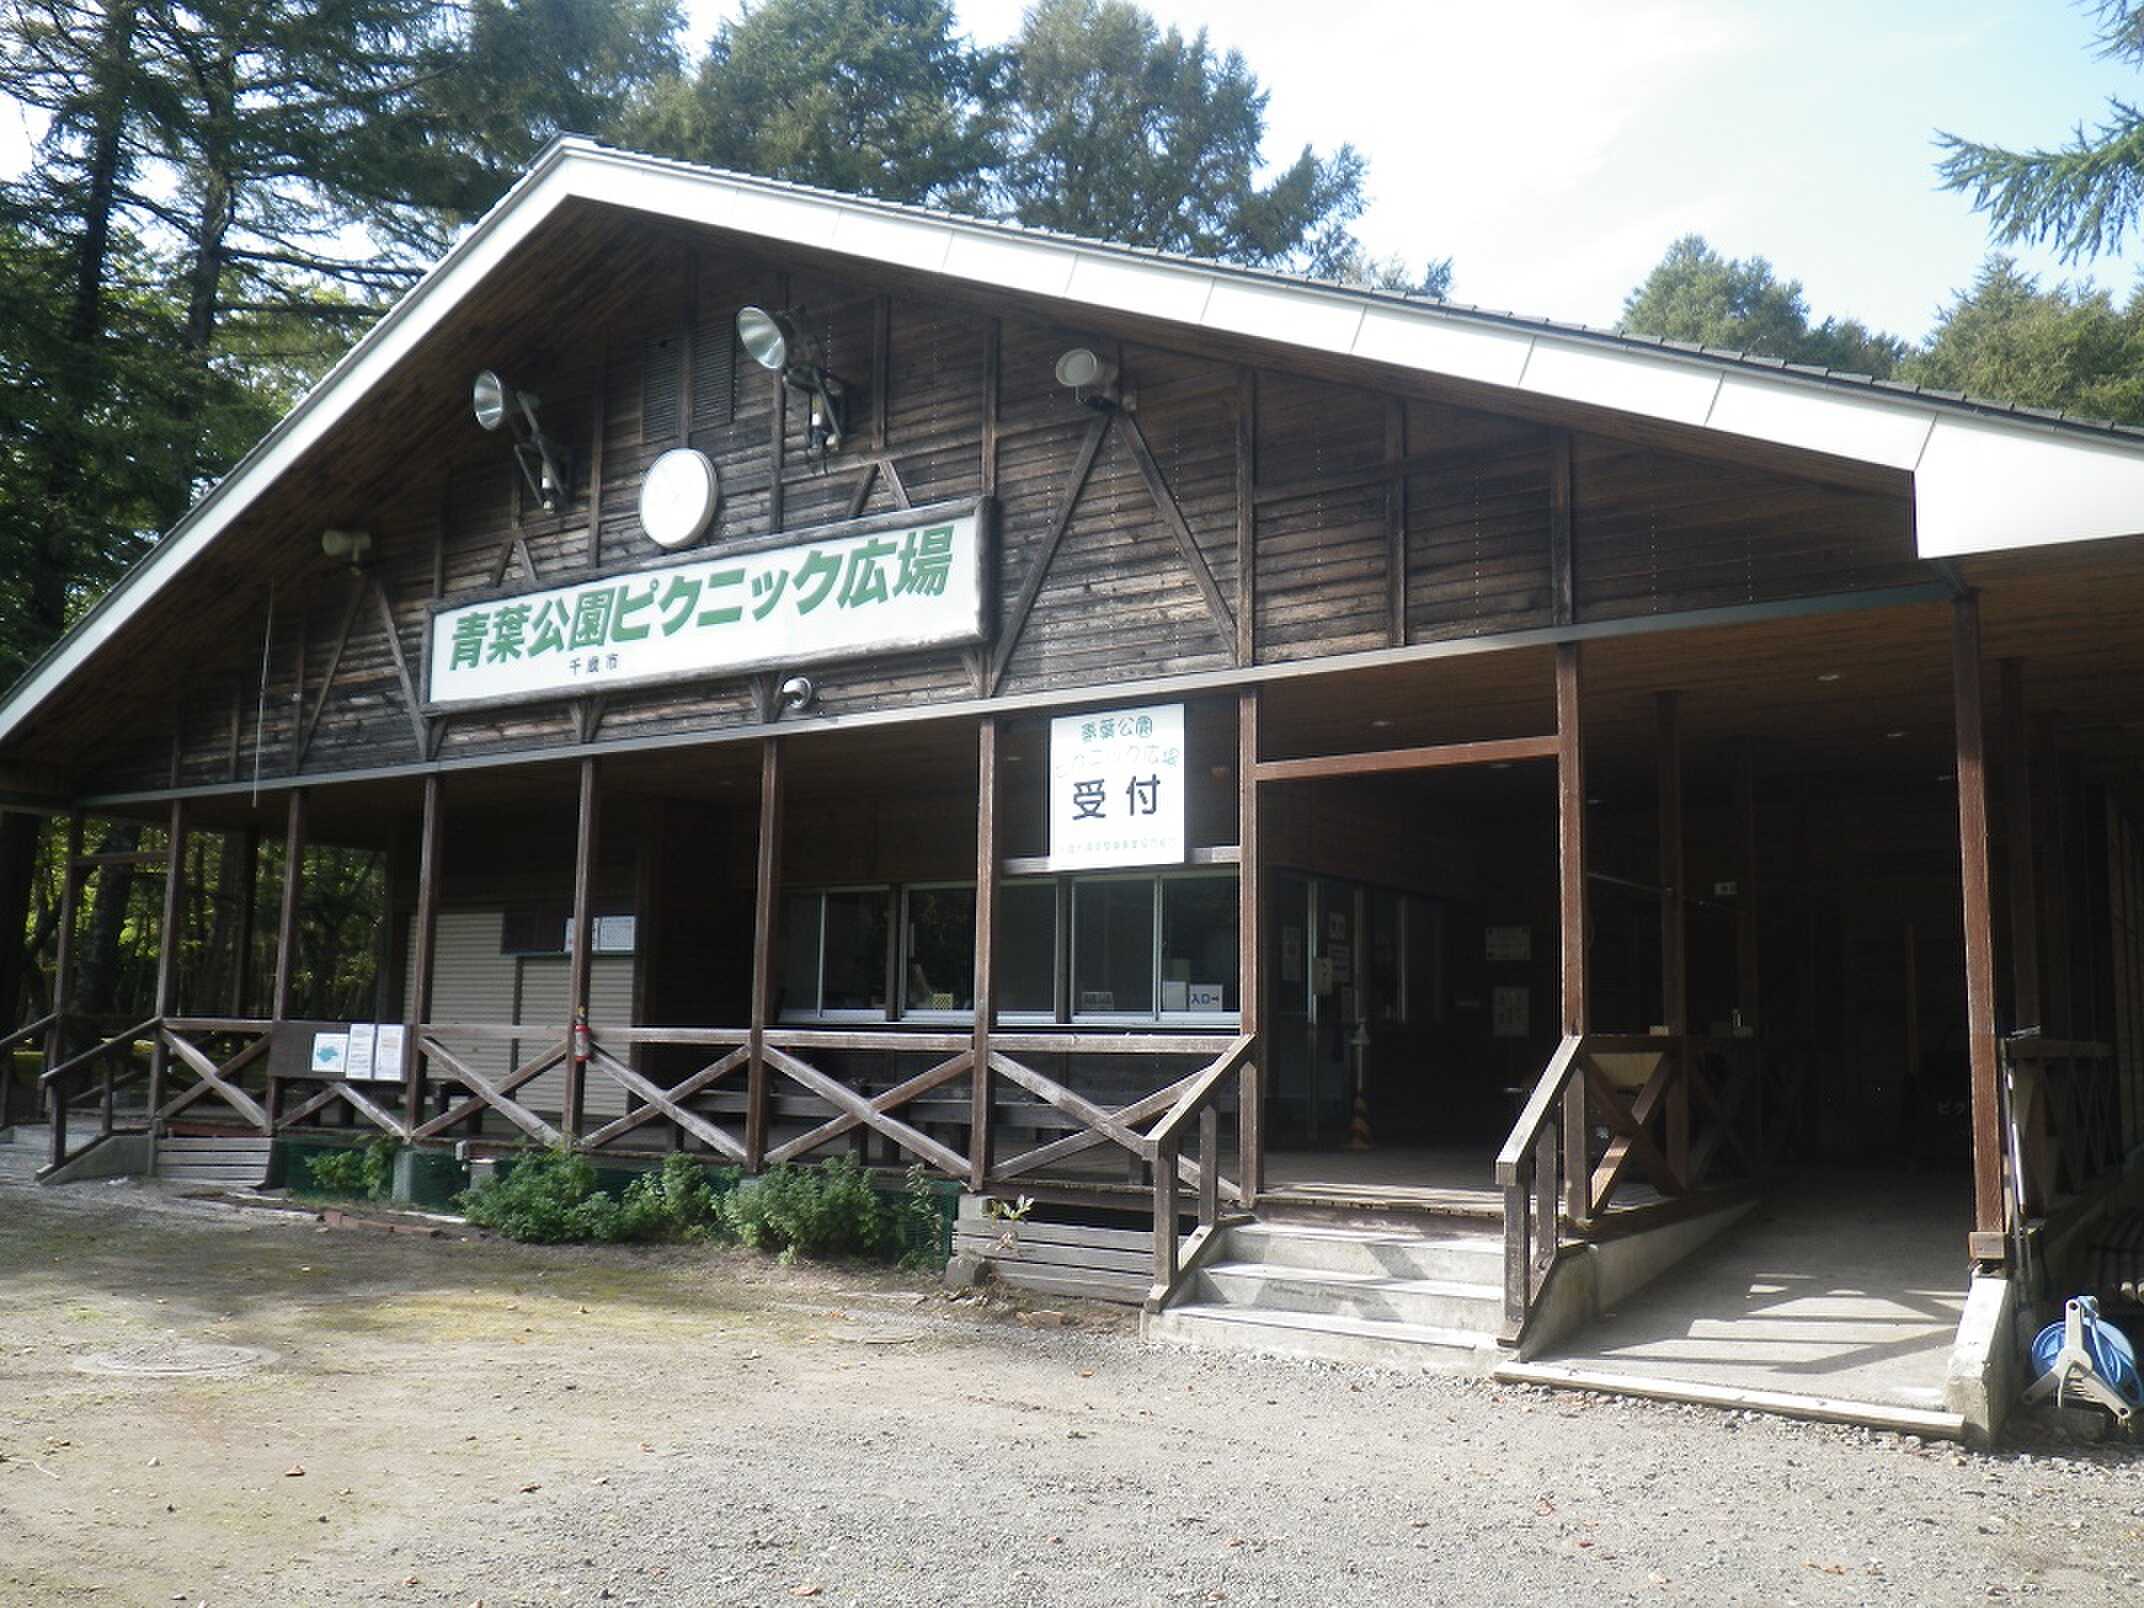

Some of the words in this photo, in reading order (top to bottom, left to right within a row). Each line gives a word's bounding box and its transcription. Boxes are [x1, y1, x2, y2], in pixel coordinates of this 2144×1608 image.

[450, 525, 954, 671] 青葉公園ピクニック広場
[569, 653, 619, 676] 千歳市
[1072, 773, 1161, 821] 受付
